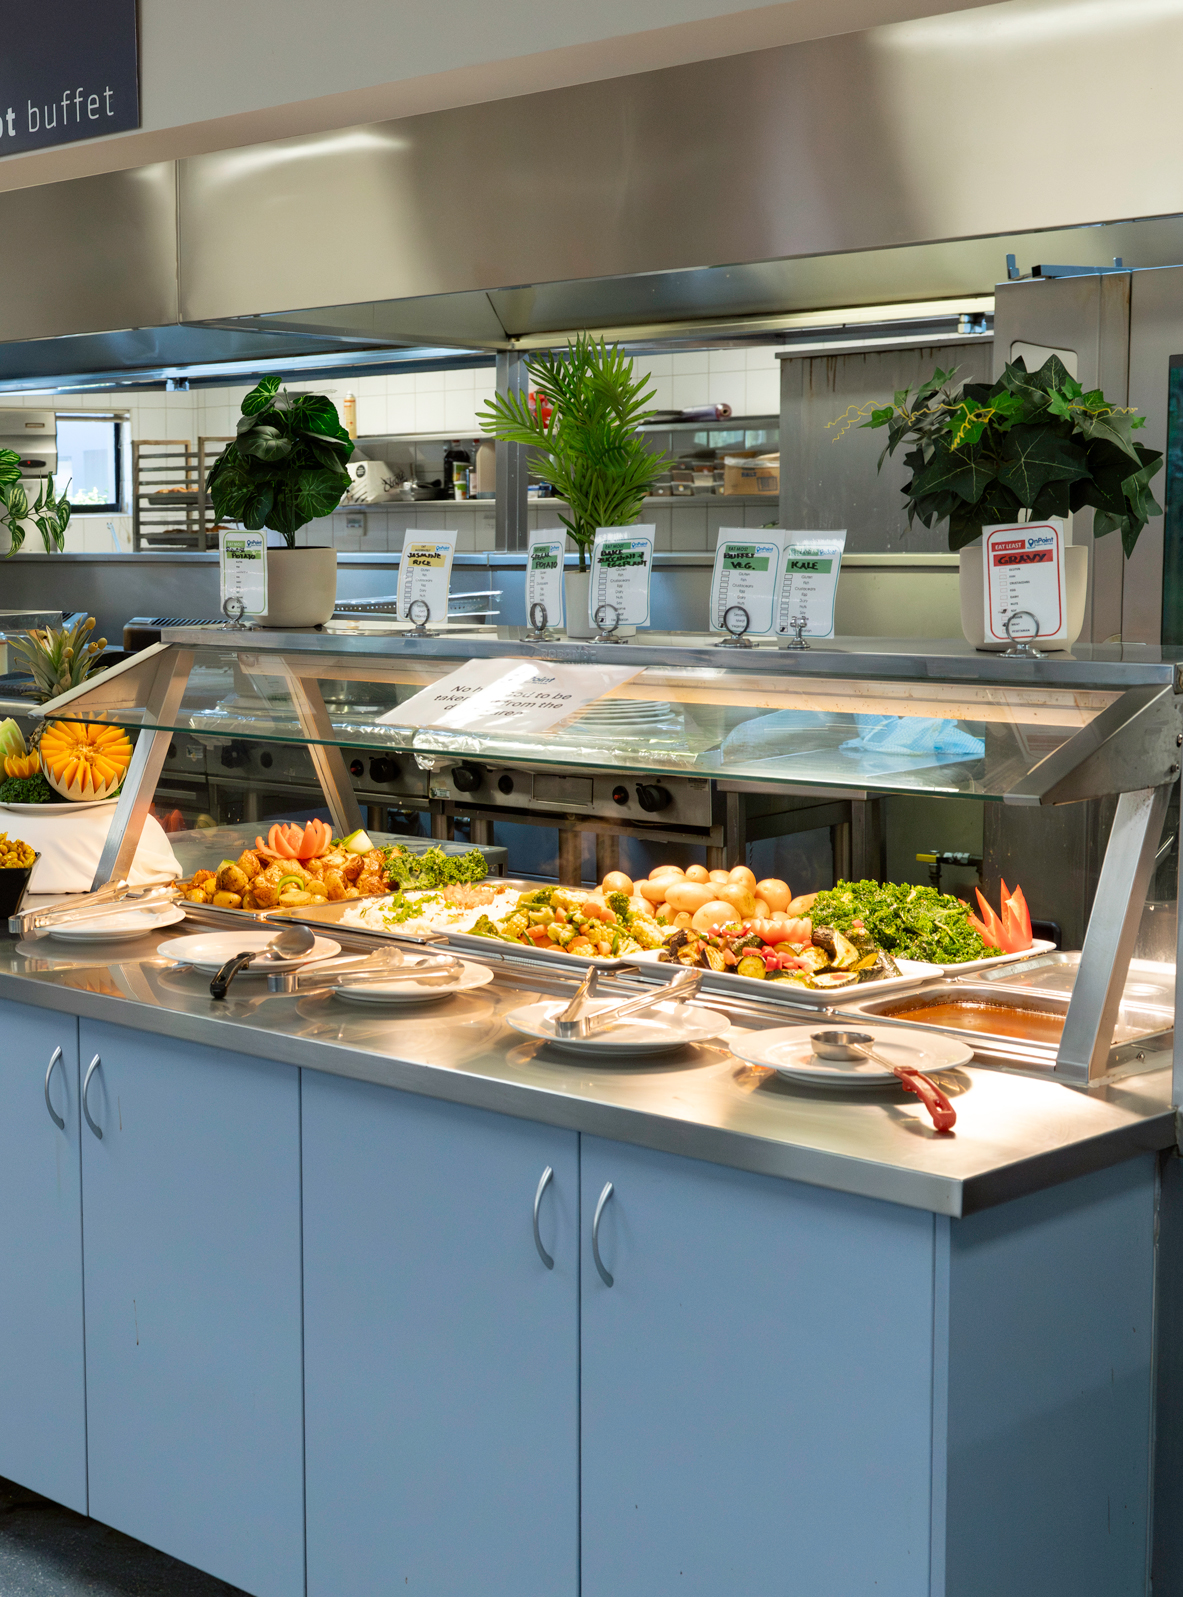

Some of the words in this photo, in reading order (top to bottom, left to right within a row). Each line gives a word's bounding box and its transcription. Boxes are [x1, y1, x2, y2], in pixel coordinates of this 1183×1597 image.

[28, 86, 114, 133] buffet
[1027, 536, 1054, 547] OnPoint
[407, 552, 442, 560] JASMINE
[997, 553, 1047, 565] GRAVY
[790, 561, 819, 570] KALE
[451, 685, 471, 693] No
[535, 692, 550, 700] to
[538, 702, 564, 710] the
